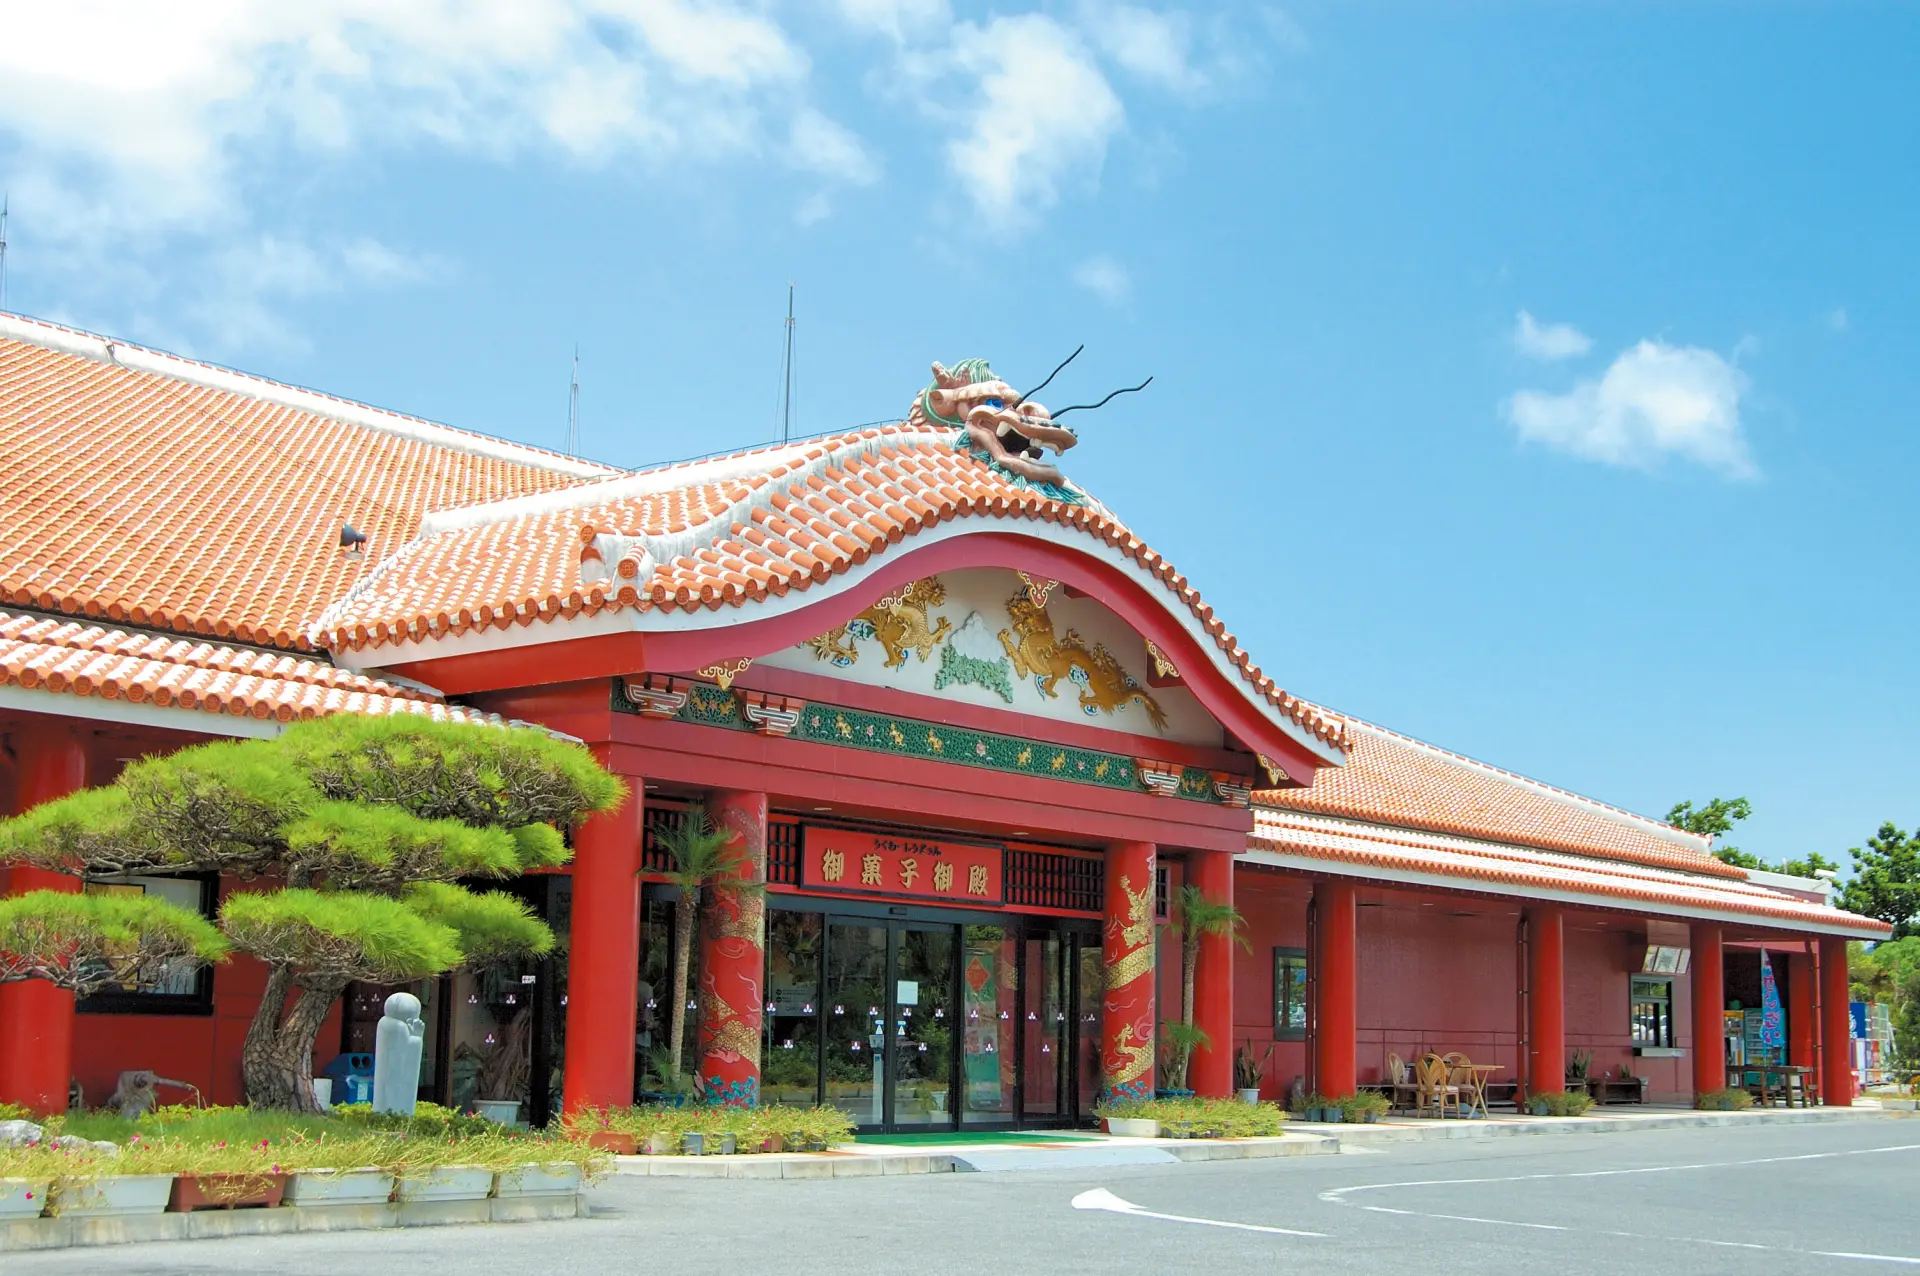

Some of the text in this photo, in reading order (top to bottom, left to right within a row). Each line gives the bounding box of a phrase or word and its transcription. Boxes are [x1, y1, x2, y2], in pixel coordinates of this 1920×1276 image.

[822, 848, 989, 896] 御菓子御殿
